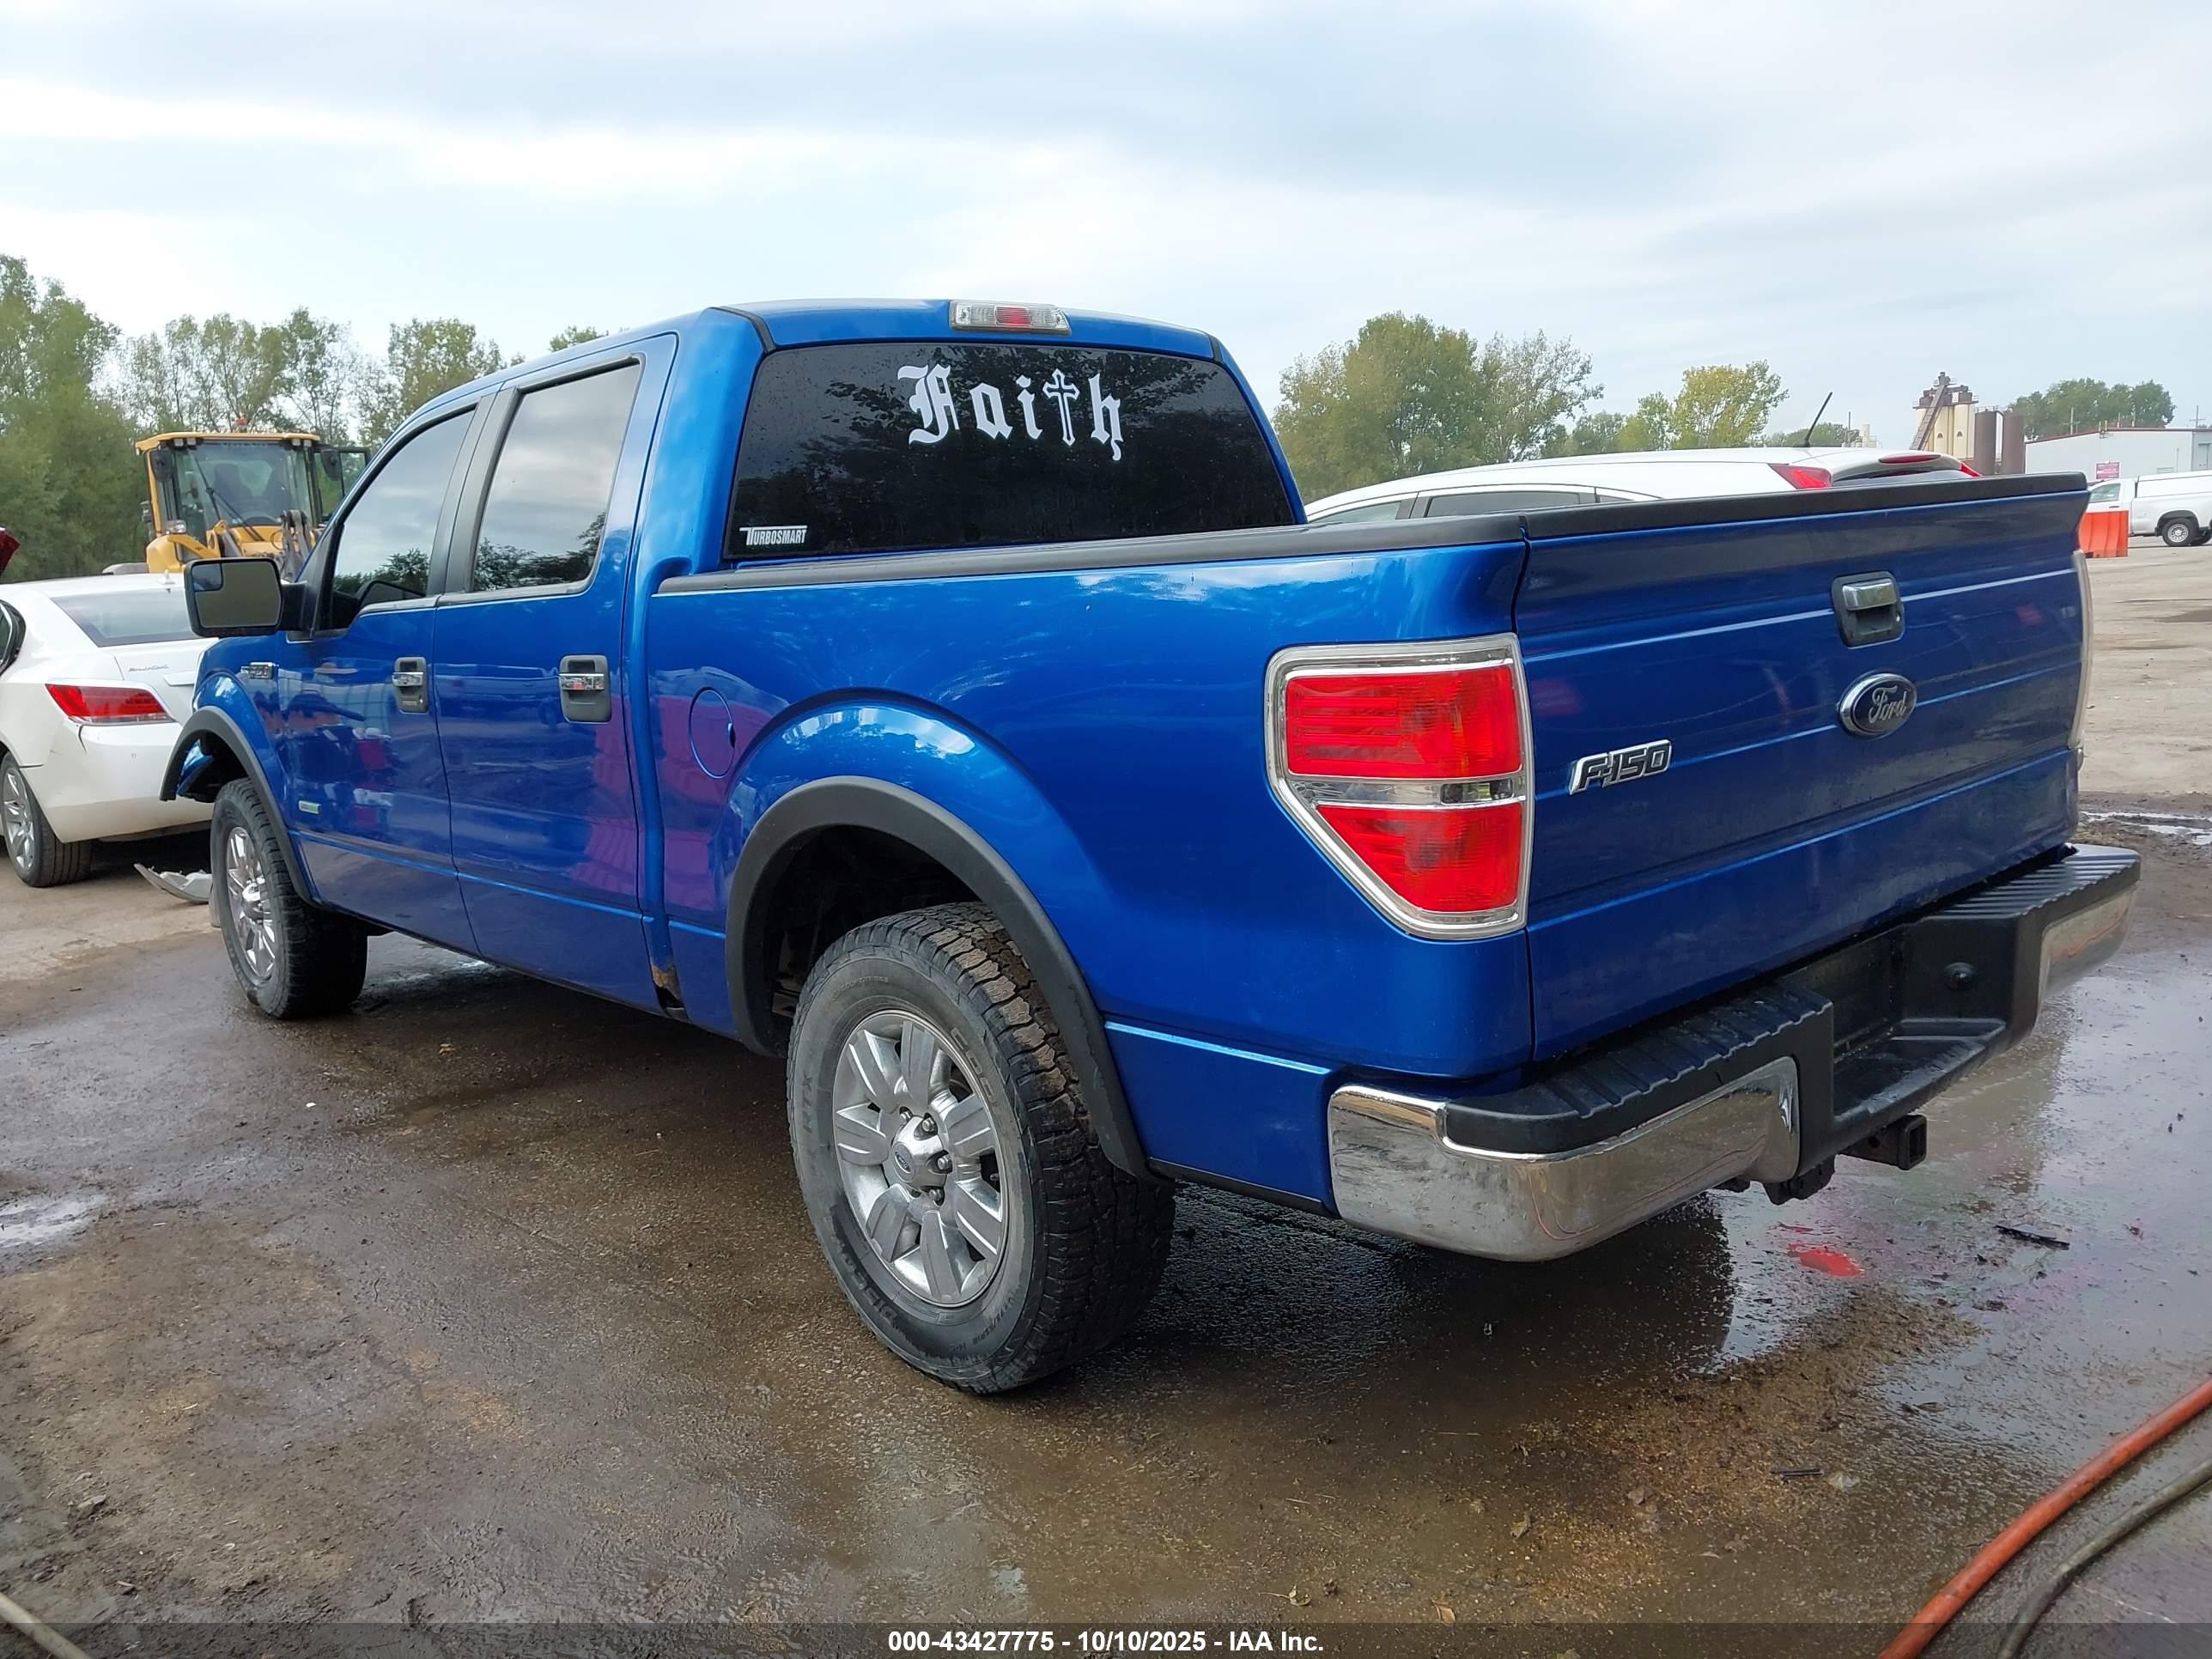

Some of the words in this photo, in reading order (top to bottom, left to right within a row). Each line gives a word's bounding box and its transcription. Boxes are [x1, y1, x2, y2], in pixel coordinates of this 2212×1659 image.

[897, 363, 1123, 461] Faith
[739, 525, 808, 546] TURBOSMART
[1868, 684, 1908, 725] Ford
[1569, 738, 1671, 795] F-150
